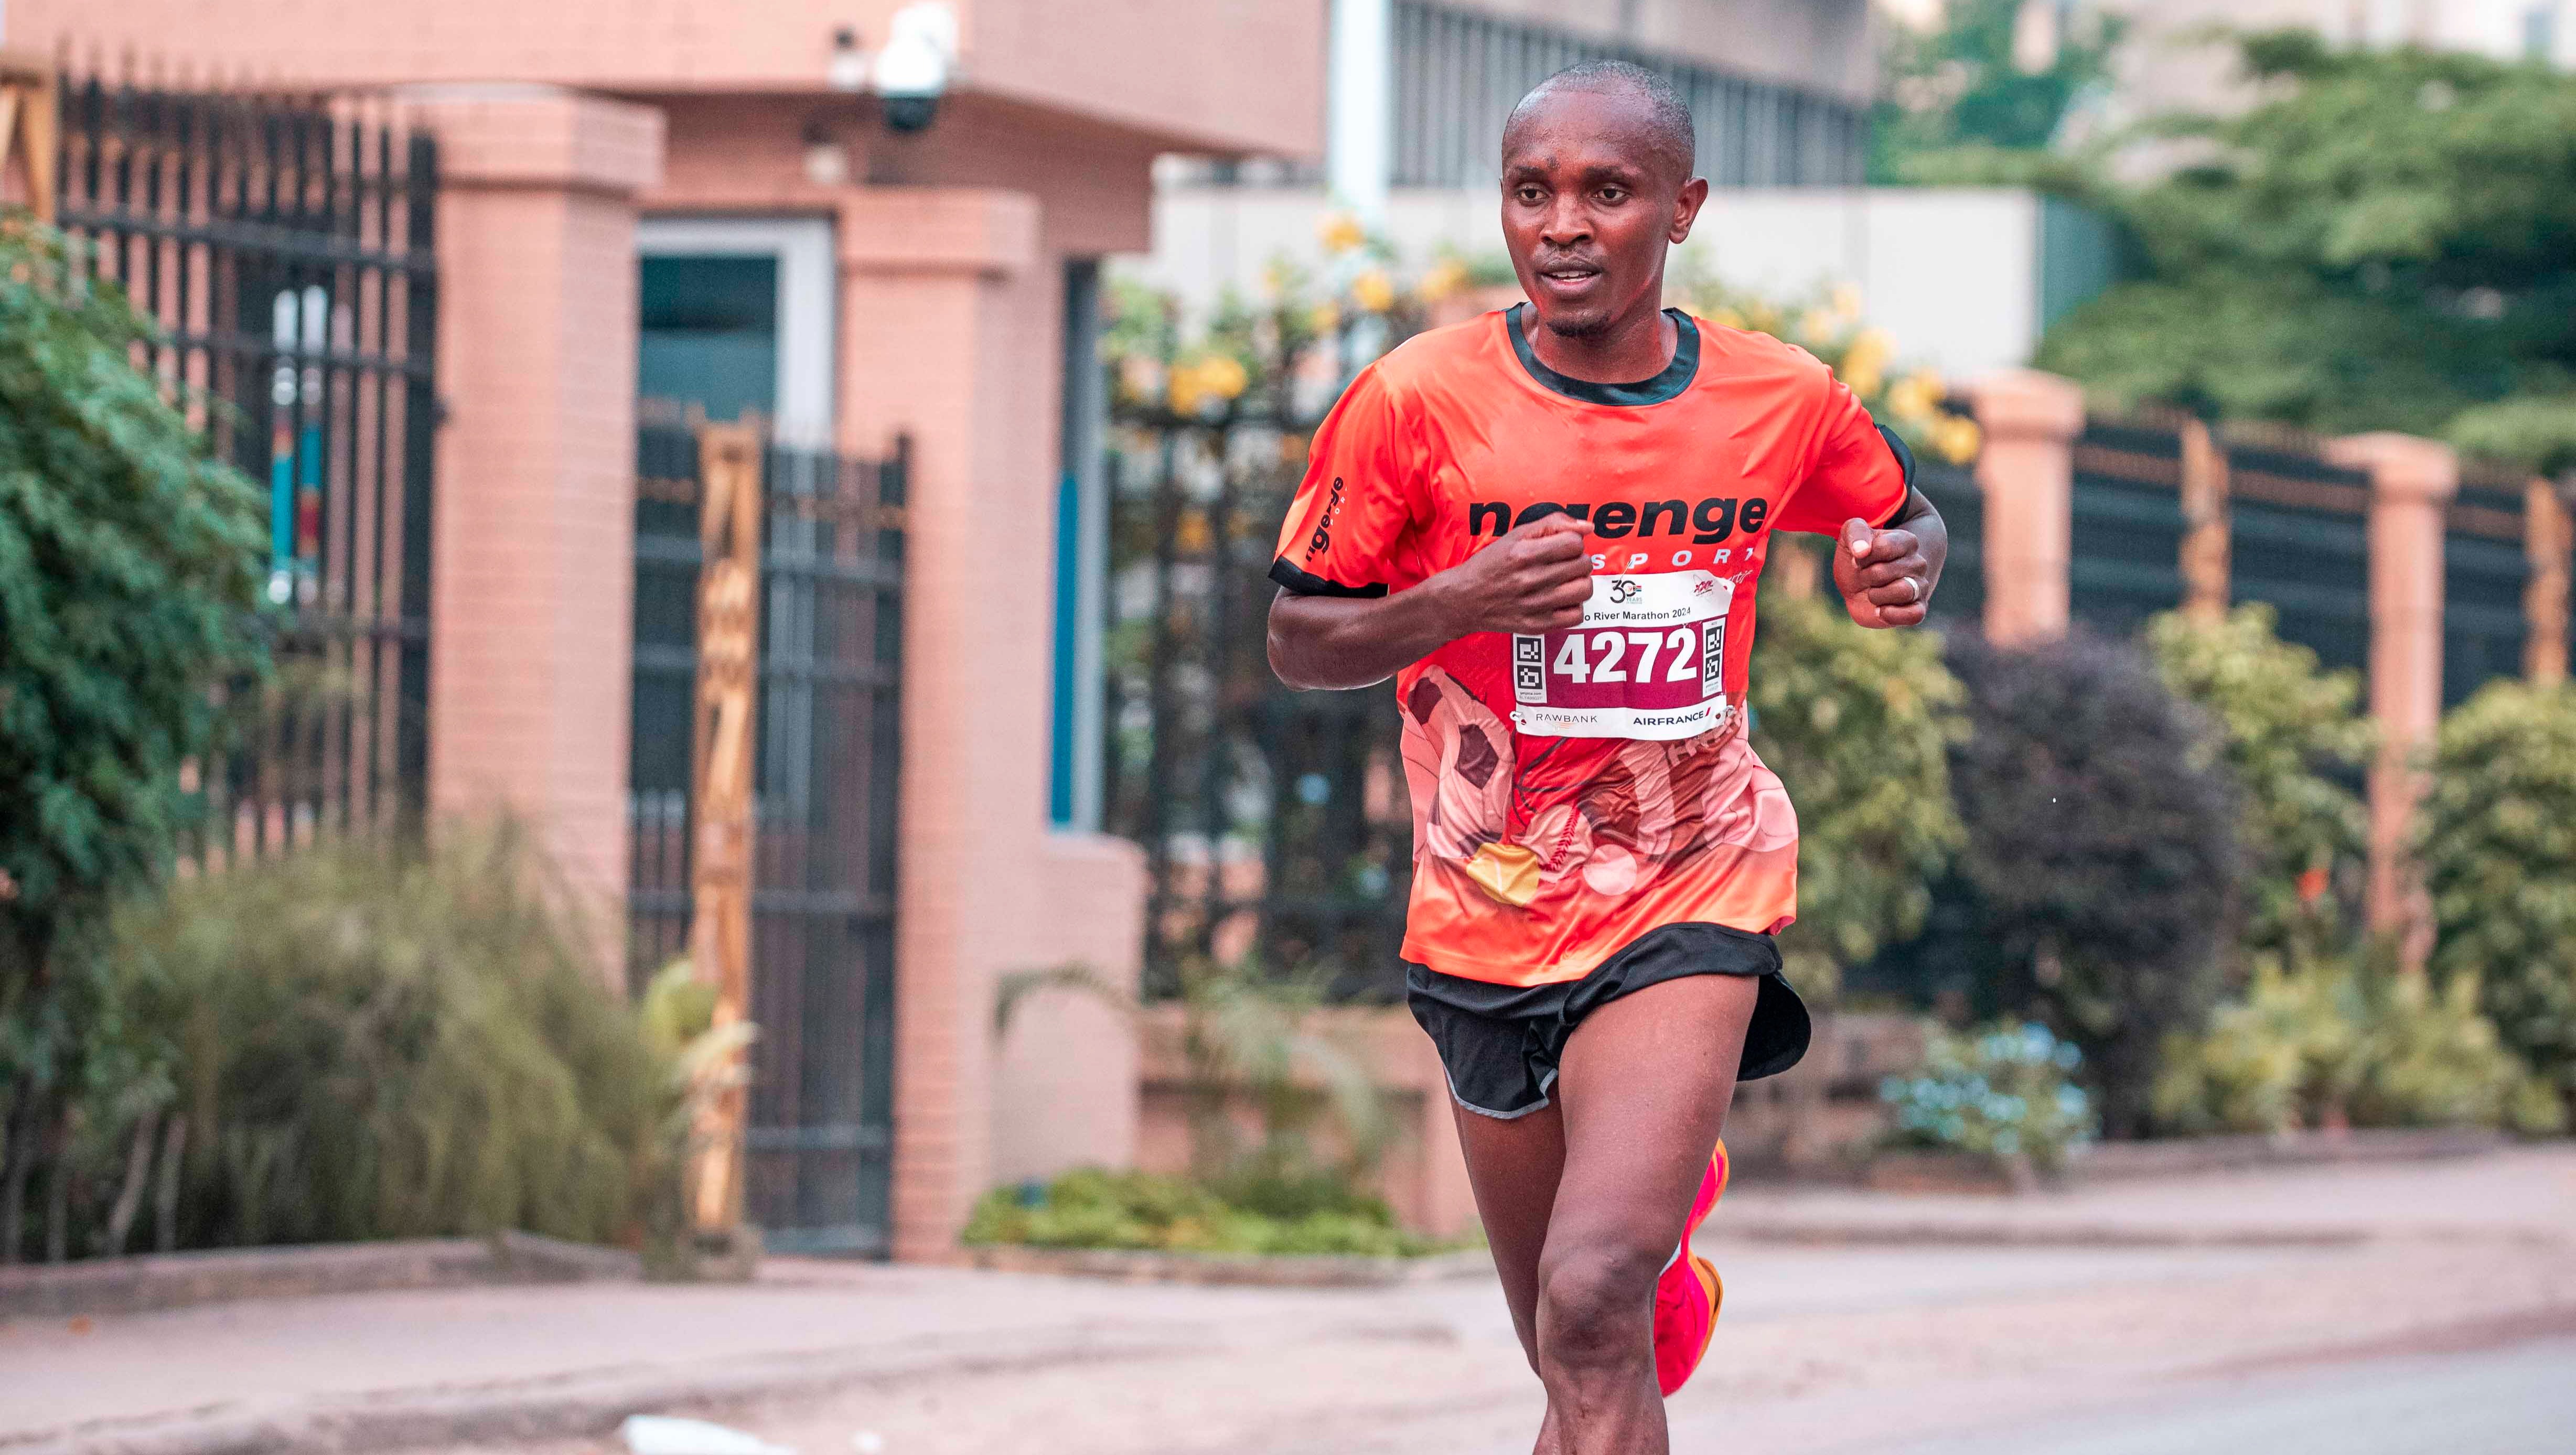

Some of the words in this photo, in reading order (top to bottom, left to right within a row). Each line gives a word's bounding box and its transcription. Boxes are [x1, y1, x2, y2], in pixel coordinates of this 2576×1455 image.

[1594, 612, 1620, 620] River
[1623, 611, 1669, 620] Marathon
[1672, 607, 1691, 618] 2024
[1553, 628, 1697, 684] 4272
[1536, 713, 1598, 723] RAWBANK
[1633, 710, 1704, 726] AIRFRANCE
